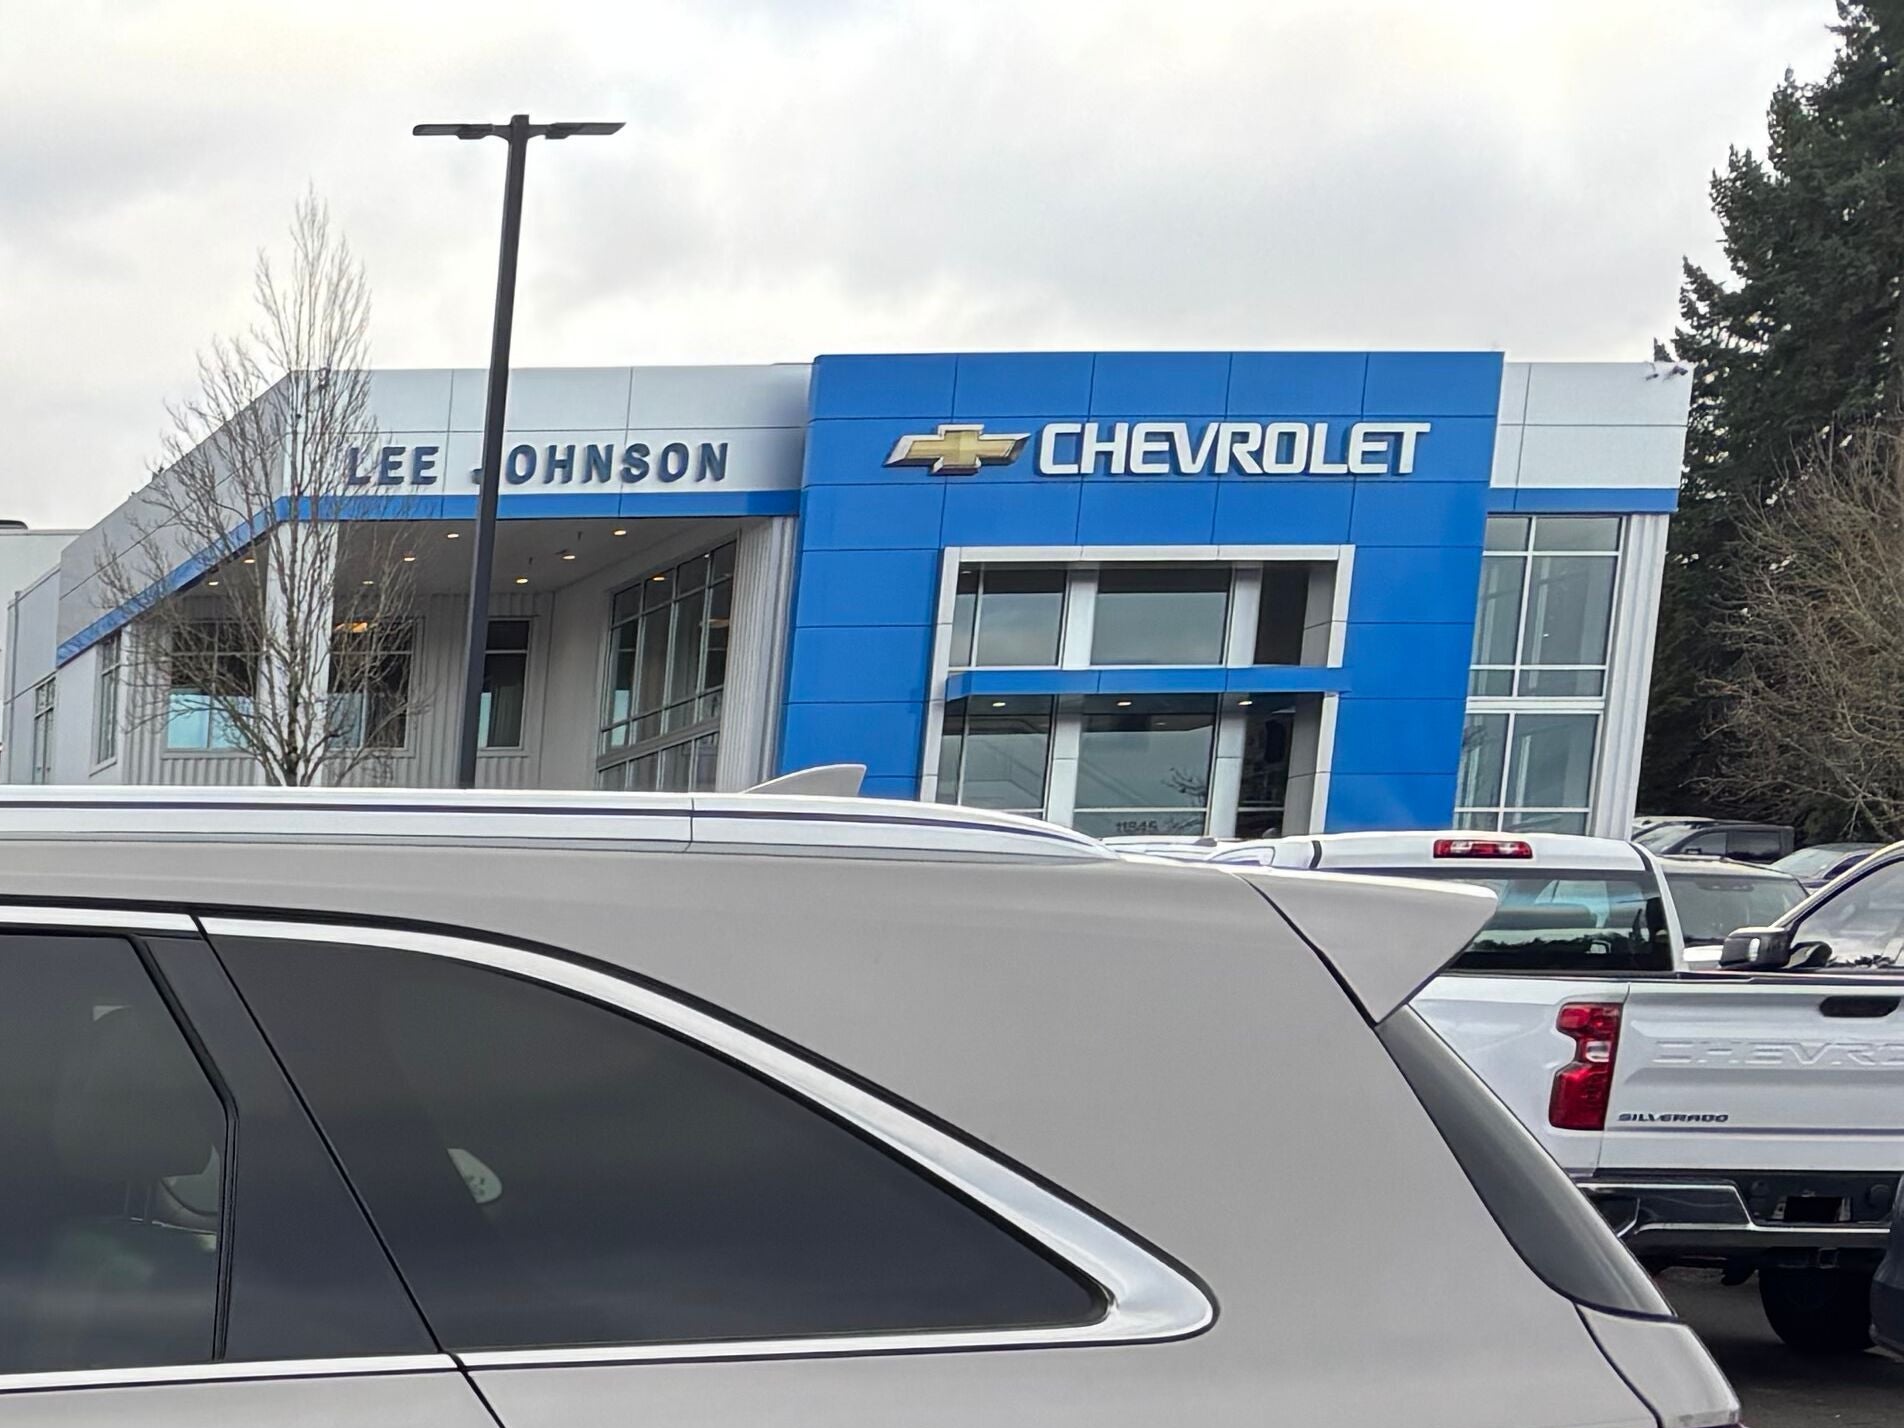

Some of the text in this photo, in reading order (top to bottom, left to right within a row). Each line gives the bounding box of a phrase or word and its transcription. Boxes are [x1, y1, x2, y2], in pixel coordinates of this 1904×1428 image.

[346, 442, 729, 487] LEE OHNSON
[1039, 421, 1431, 475] CHEVROLET
[1617, 1113, 1729, 1123] SILVERADO
